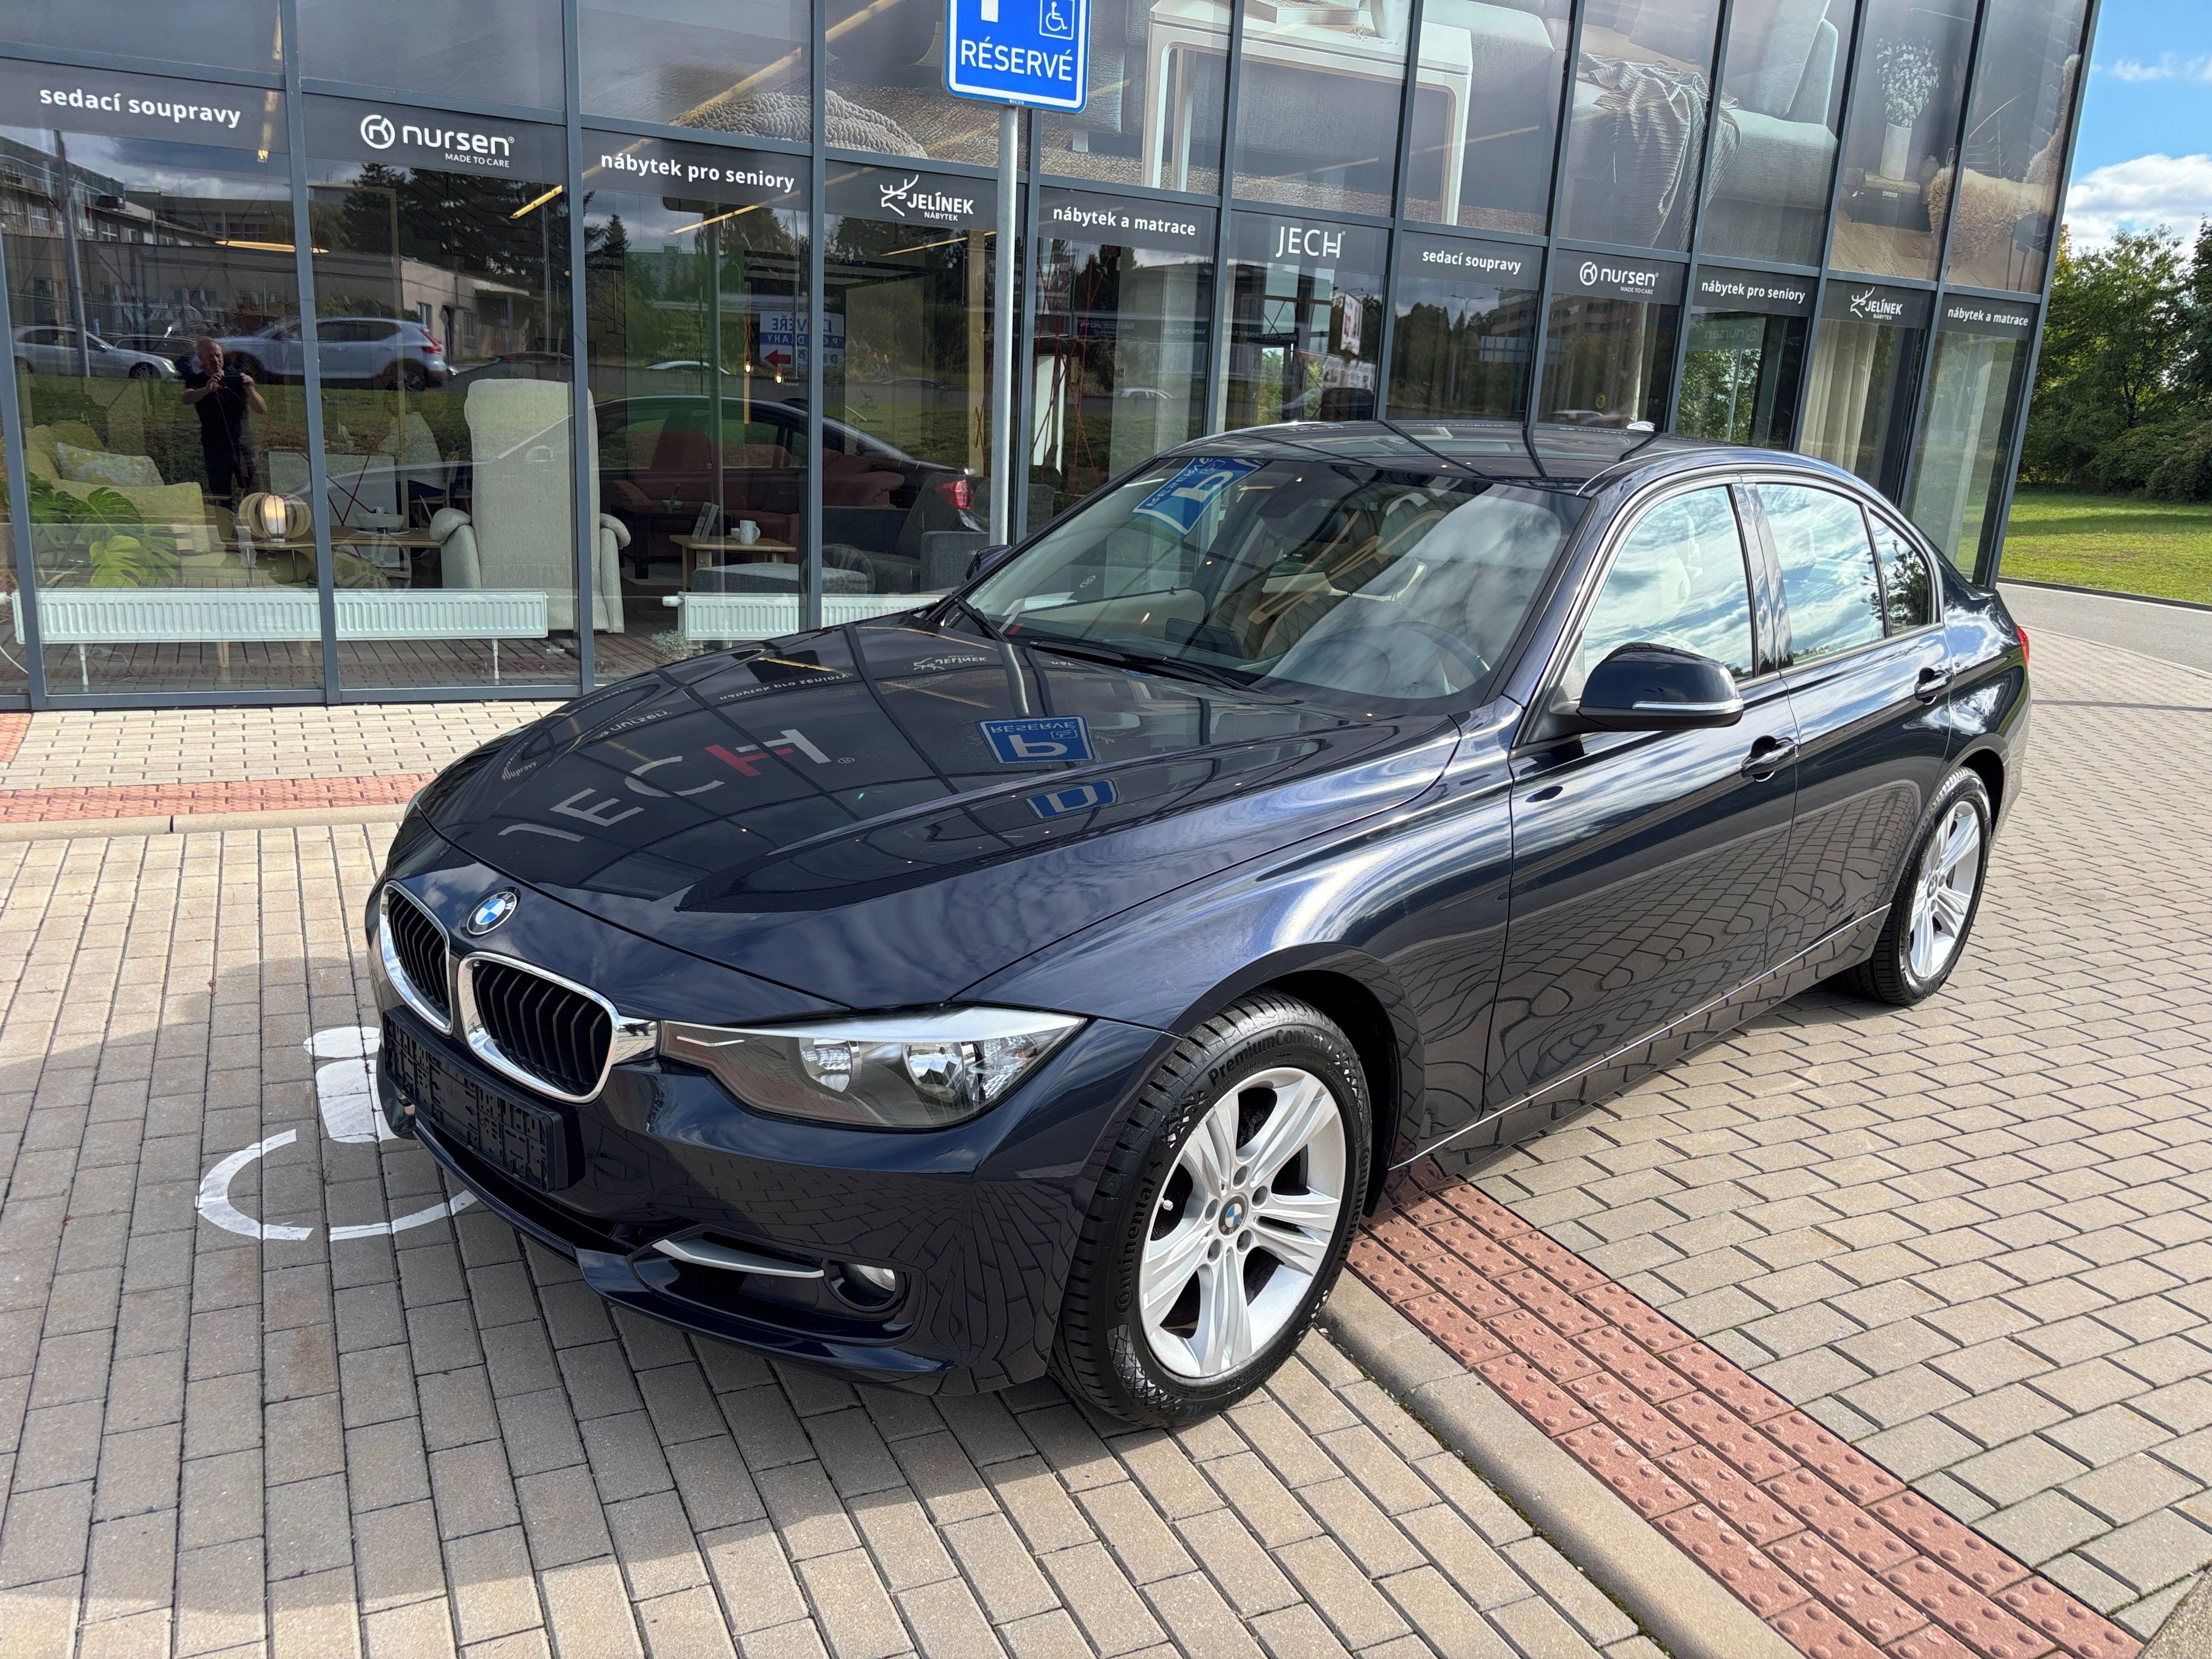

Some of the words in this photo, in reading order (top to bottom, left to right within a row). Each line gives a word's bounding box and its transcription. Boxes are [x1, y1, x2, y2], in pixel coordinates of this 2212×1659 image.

[961, 36, 1073, 81] RÉSERVÉ
[40, 89, 122, 111] sedací
[128, 99, 241, 129] soupravy
[403, 126, 510, 156] nursen
[445, 153, 471, 163] MADE
[473, 156, 485, 165] TO
[487, 158, 510, 168] CARE
[601, 153, 682, 177] nábytek
[688, 165, 720, 182] pro
[726, 170, 794, 193] seniory
[907, 191, 974, 215] JELÍNEK
[924, 209, 958, 221] NÁBYTEK
[1053, 206, 1116, 227] nábytek
[1121, 216, 1129, 228] a
[1134, 218, 1196, 236] matrace
[1276, 226, 1342, 259] JECH
[1422, 250, 1464, 266] sedací
[1465, 256, 1521, 275] soupravy
[1600, 268, 1656, 287] nursen
[1701, 280, 1745, 297] nábytek
[1747, 286, 1765, 299] pro
[1767, 288, 1805, 304] seniory
[1865, 298, 1904, 315] JELÍNEK
[1948, 307, 1985, 323] nábytek
[1985, 313, 1991, 322] a
[1993, 314, 2029, 326] matrace
[1114, 1176, 1157, 1314] Continental
